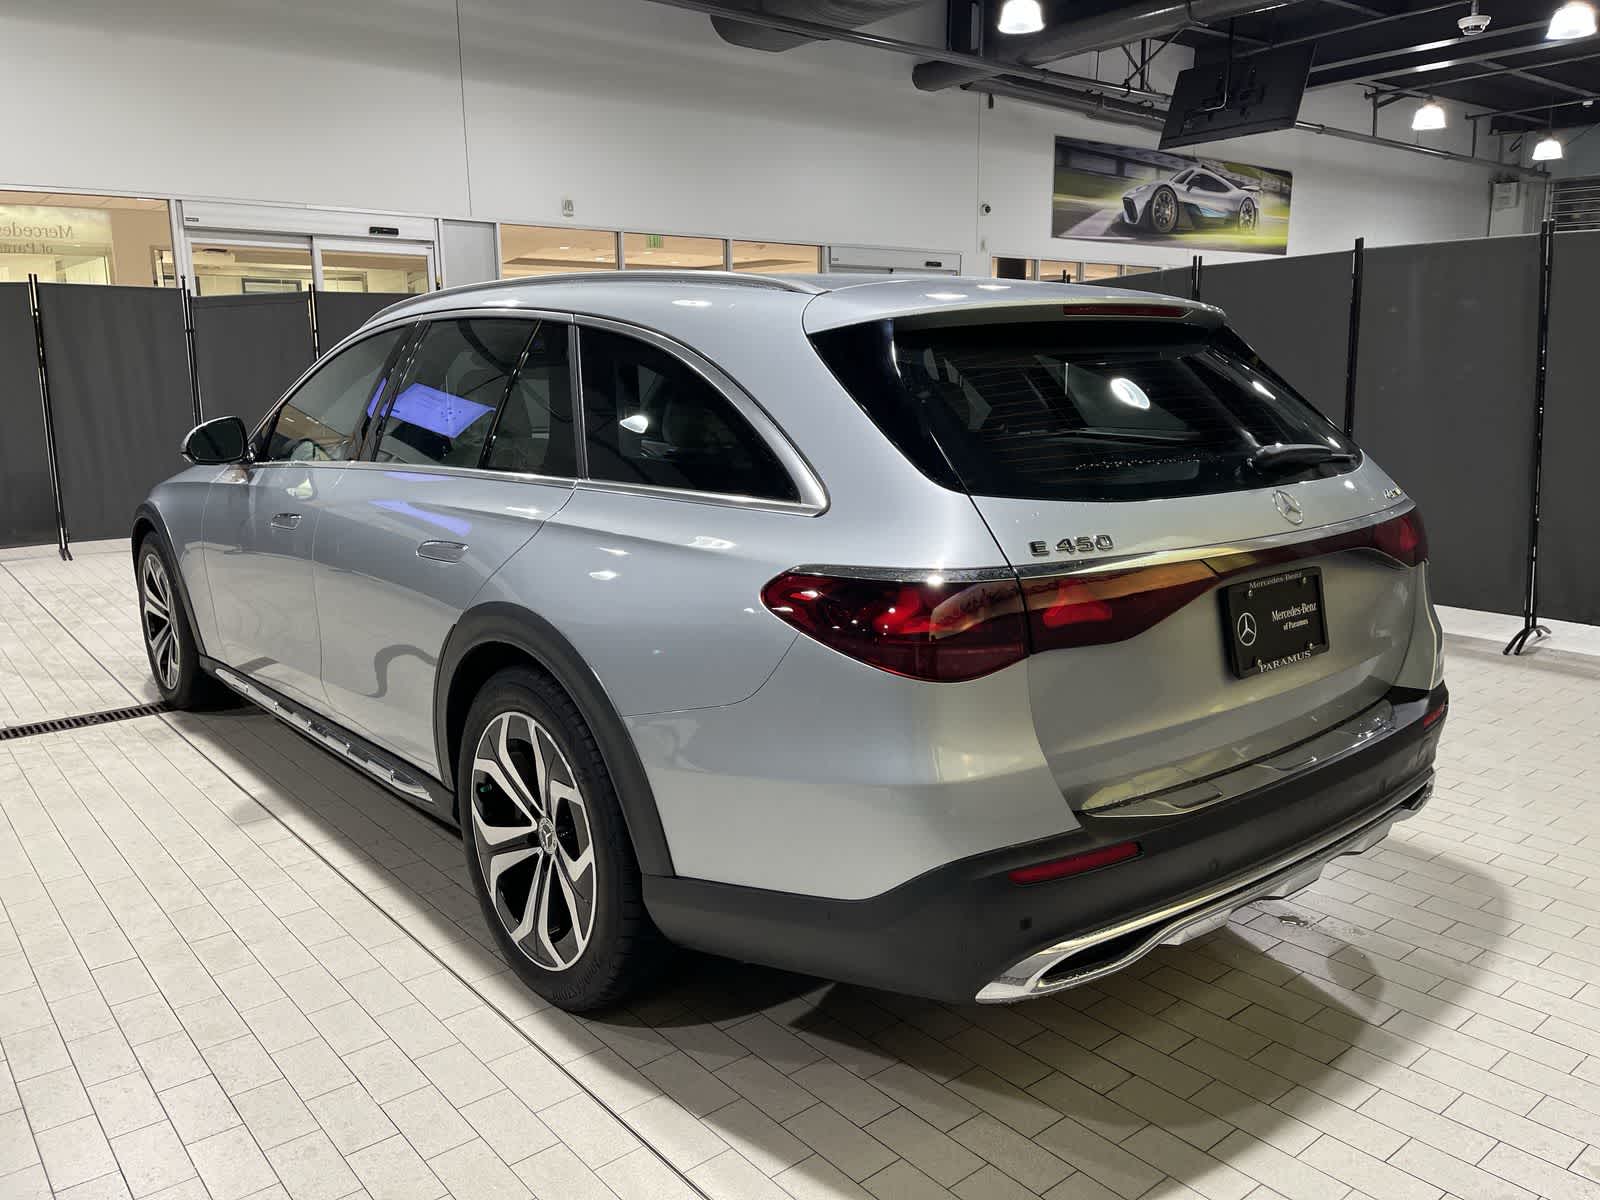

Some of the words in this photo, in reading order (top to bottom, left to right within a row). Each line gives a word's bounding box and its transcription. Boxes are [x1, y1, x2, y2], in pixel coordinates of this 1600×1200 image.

[1029, 540, 1050, 557] E
[1055, 534, 1114, 554] 450
[1271, 602, 1317, 622] Mercedes-Benz
[1259, 649, 1311, 673] PARAMUS
